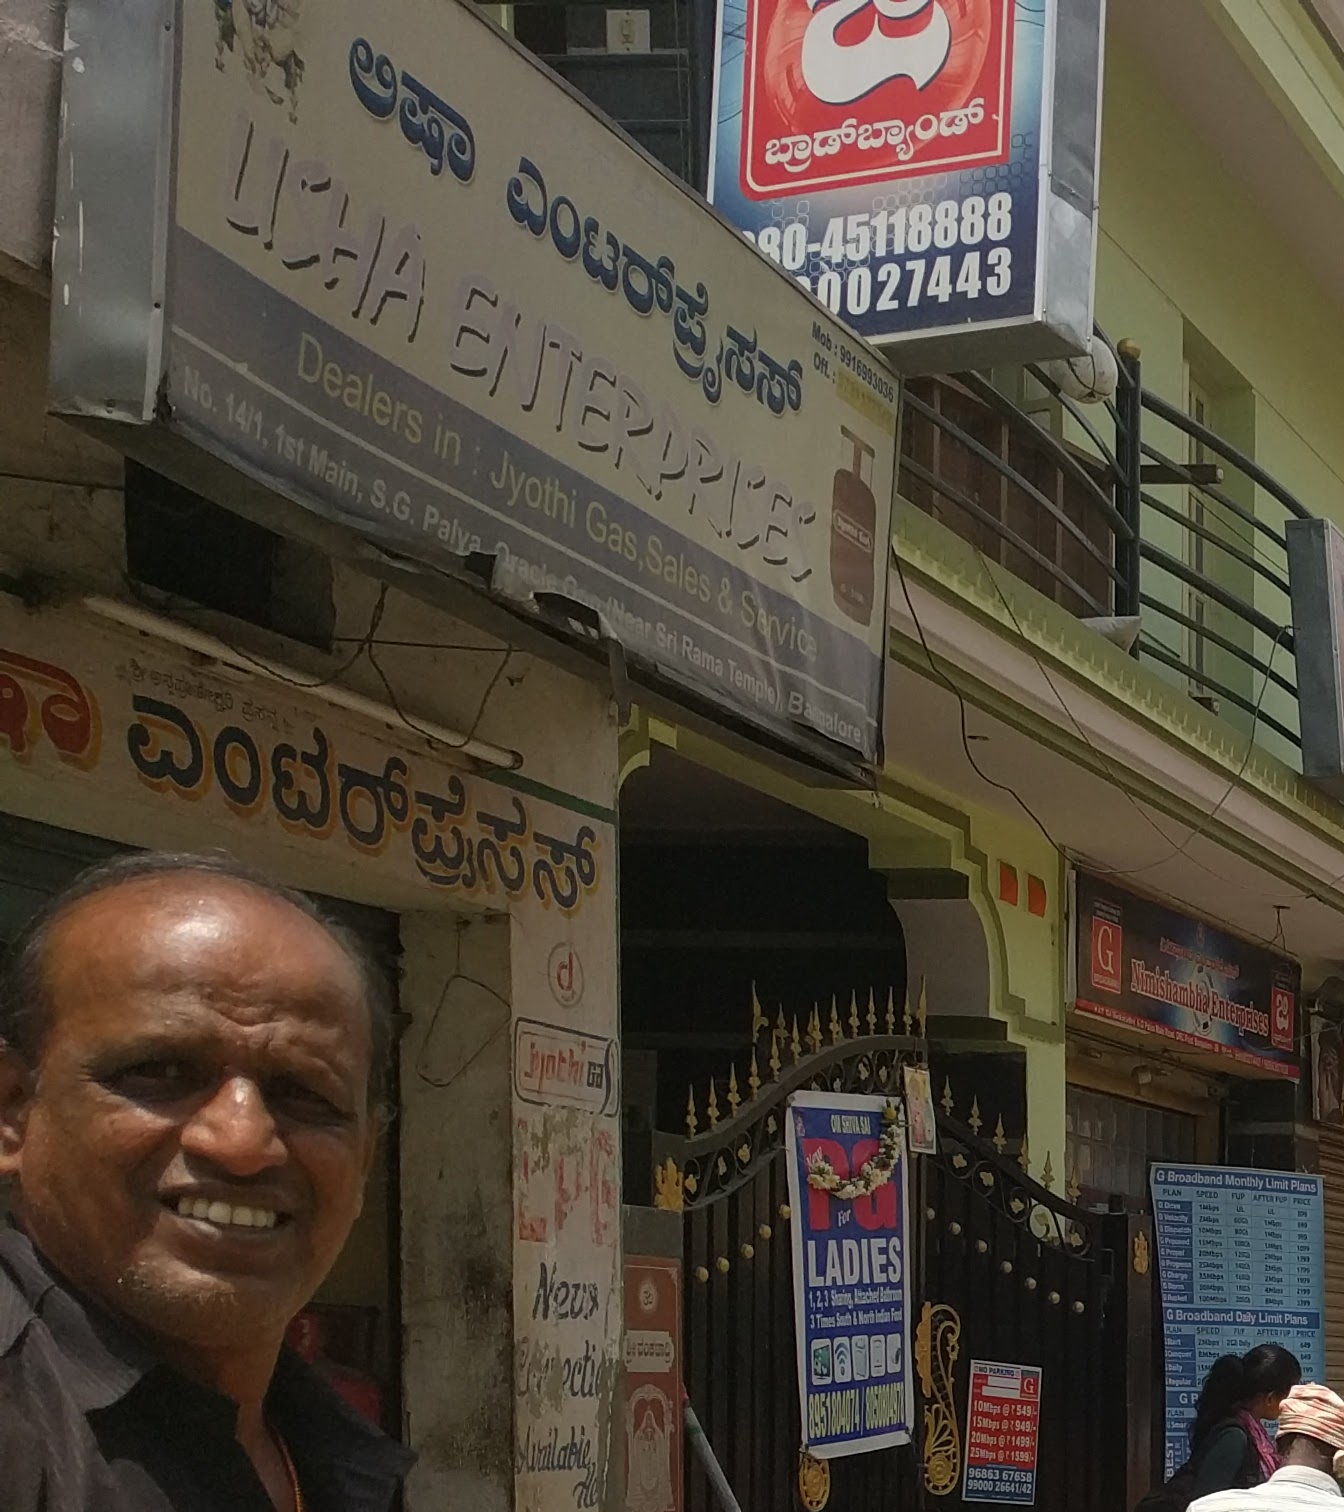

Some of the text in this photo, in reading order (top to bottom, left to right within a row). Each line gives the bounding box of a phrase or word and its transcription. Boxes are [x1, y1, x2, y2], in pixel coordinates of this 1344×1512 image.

[742, 192, 1012, 271] 80-45118888
[796, 247, 1012, 317] 0027443
[812, 321, 832, 352] Mob
[840, 345, 894, 404] 9916993036
[297, 332, 422, 444] Dealers
[434, 414, 461, 466] in
[491, 451, 577, 529] Jyothi
[719, 577, 733, 614] &
[741, 590, 818, 664] Service
[184, 365, 217, 413] No.
[225, 393, 268, 449] 14/1,
[274, 424, 304, 467] 1st
[308, 445, 363, 503] Main,
[370, 479, 416, 526] S.G.
[655, 622, 678, 655] Sri
[682, 633, 724, 677] Rama
[1098, 926, 1114, 975] G
[1210, 989, 1269, 1037] Enterprises
[1157, 1171, 1317, 1193] G Broadband Monthly Limit Plans
[1163, 1189, 1182, 1197] PLAN
[838, 1209, 851, 1227] For
[807, 1237, 901, 1287] LADIES
[824, 1290, 829, 1307] 3
[810, 1314, 815, 1329] 3
[1167, 1309, 1174, 1320] G
[1176, 1310, 1233, 1322] Broadband
[1259, 1312, 1282, 1324] Limit
[1284, 1313, 1308, 1325] Plans
[1296, 1330, 1316, 1338] PRICE
[1023, 1378, 1034, 1394] G
[1180, 1393, 1188, 1404] G
[1002, 1404, 1010, 1416] @
[1001, 1420, 1009, 1431] @
[998, 1435, 1005, 1447] @
[997, 1450, 1004, 1462] @
[969, 1468, 1032, 1483] 96863 67658
[967, 1479, 1032, 1494] 99000 26641/42
